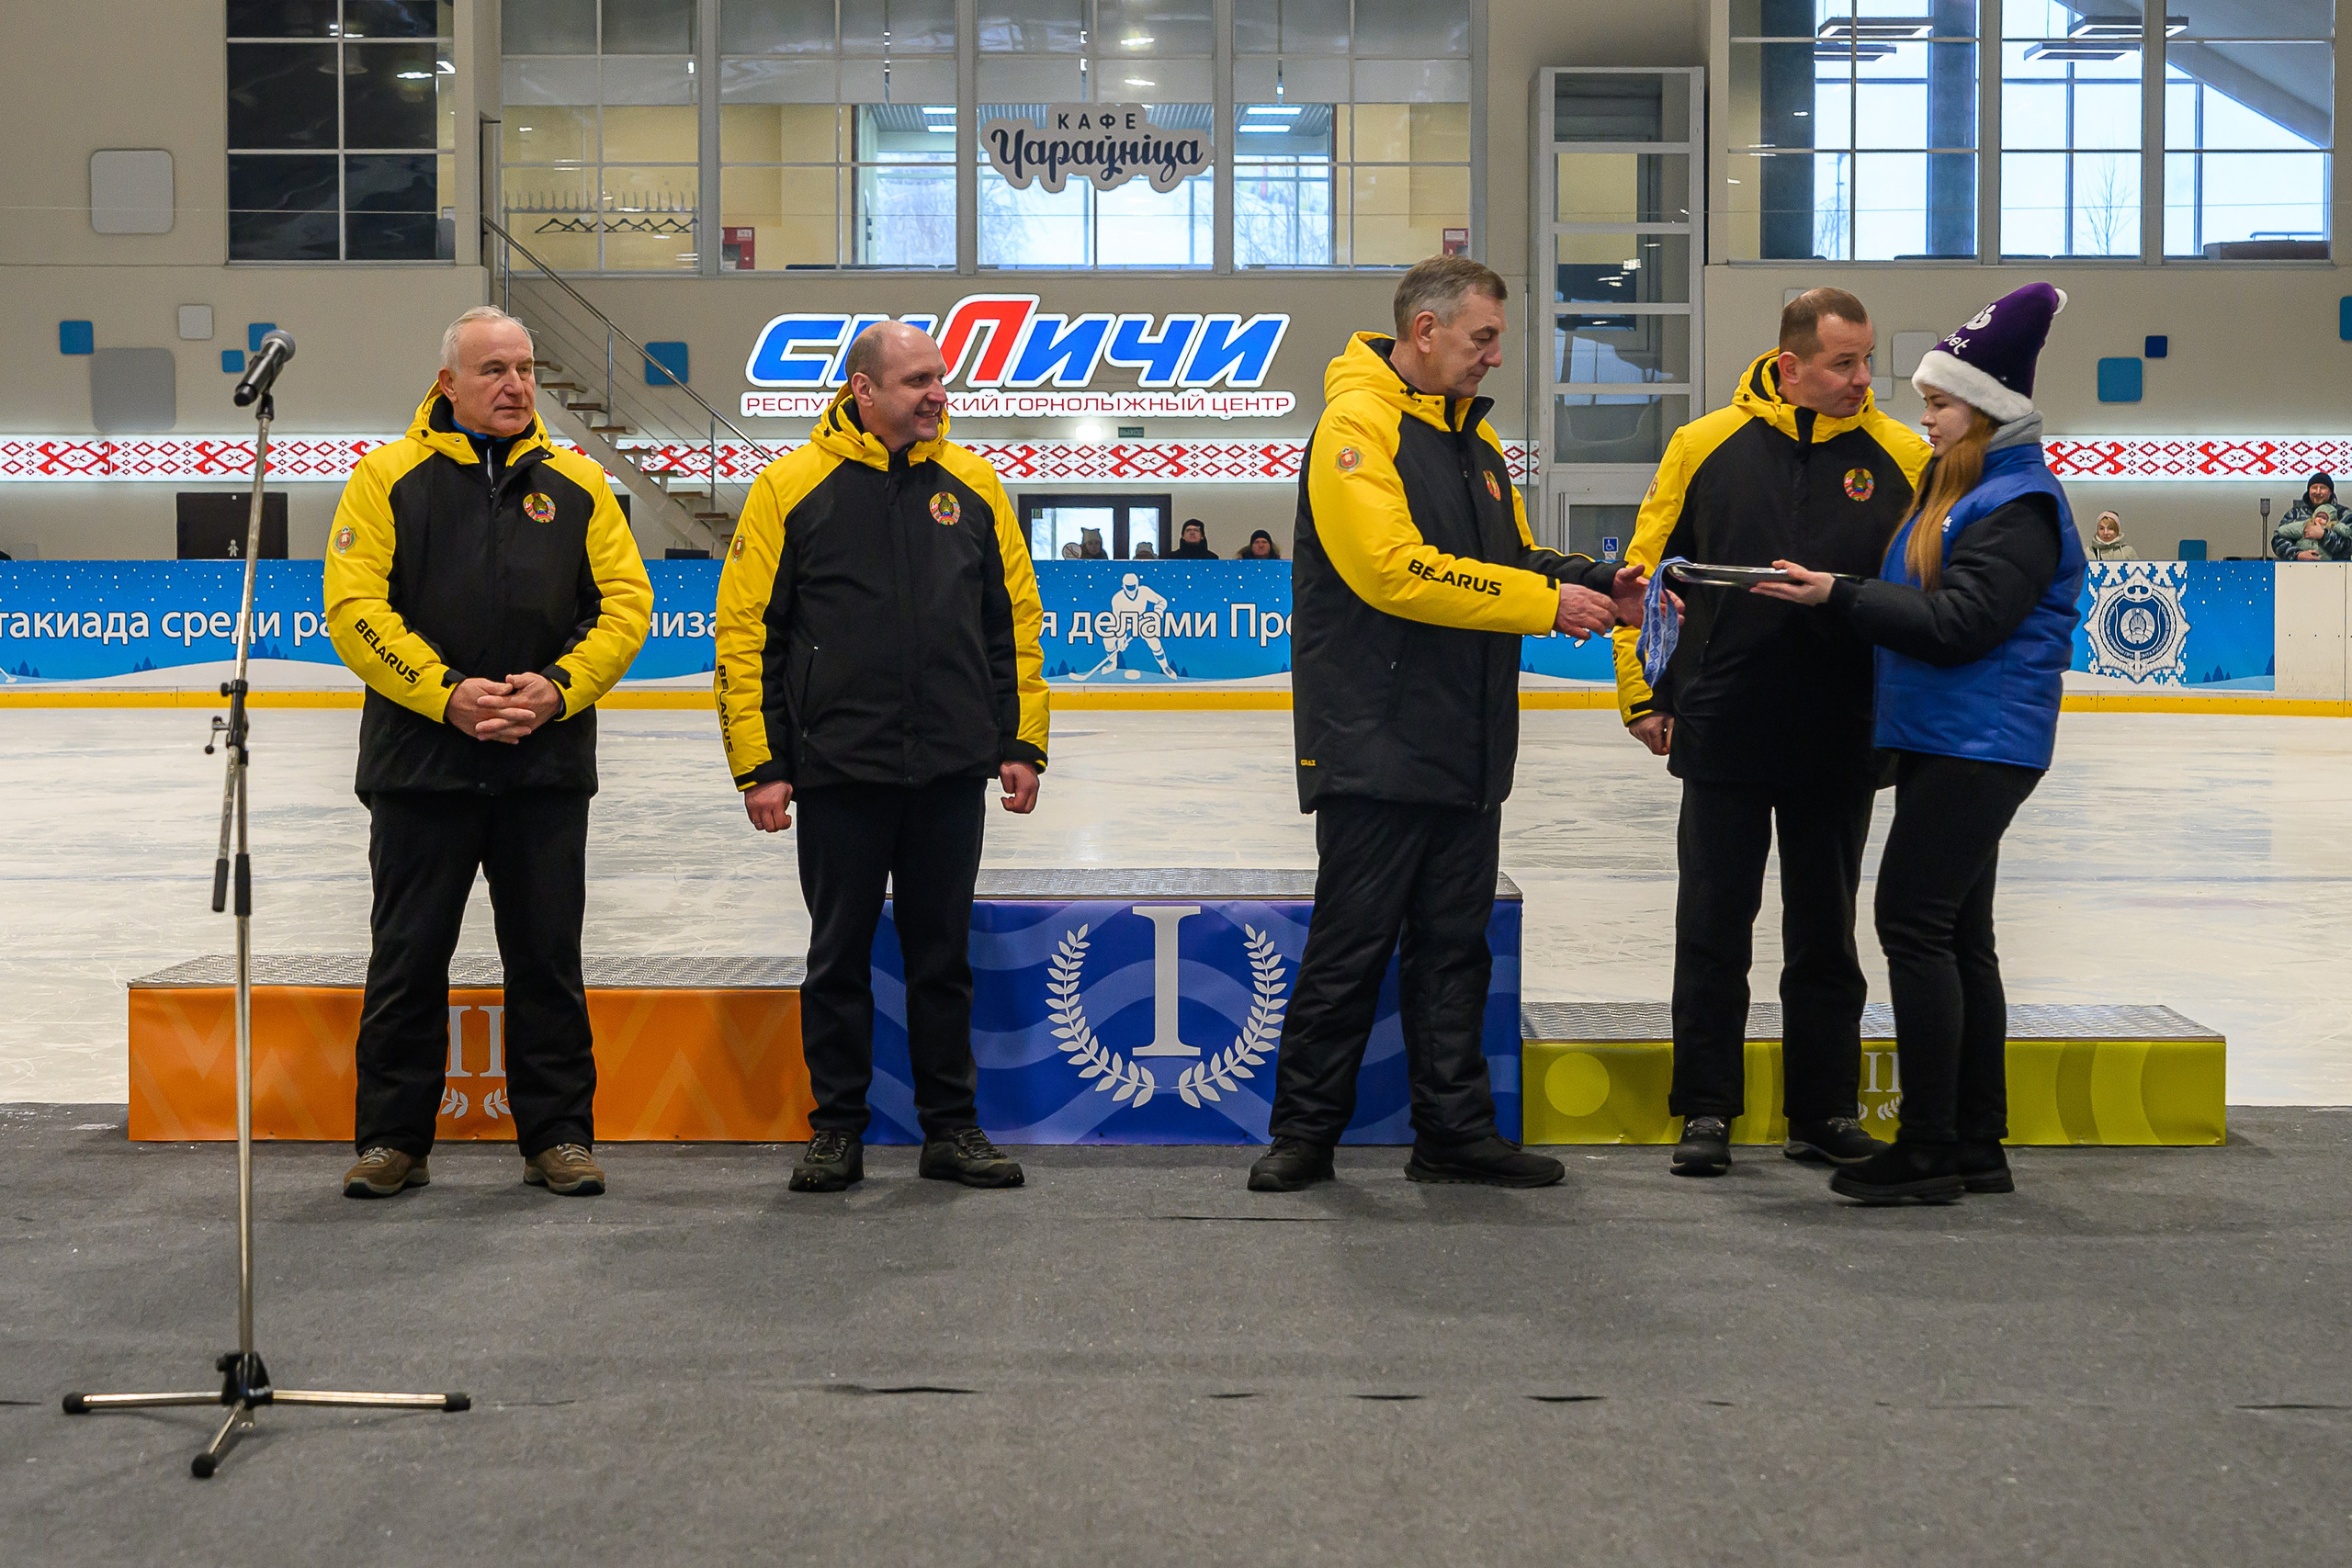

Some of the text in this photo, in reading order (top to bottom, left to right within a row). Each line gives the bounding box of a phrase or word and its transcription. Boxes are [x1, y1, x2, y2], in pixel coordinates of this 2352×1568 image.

[1057, 112, 1136, 130] КАФЕ
[989, 129, 1204, 183] Чараўніца
[747, 296, 1290, 387] СЛИЧИ
[1005, 393, 1205, 412] ГОРНОЛЫЖНЫЙ
[1212, 397, 1291, 414] ЦЕНТР
[1067, 611, 1218, 645] делами
[354, 618, 421, 684] BELARUS
